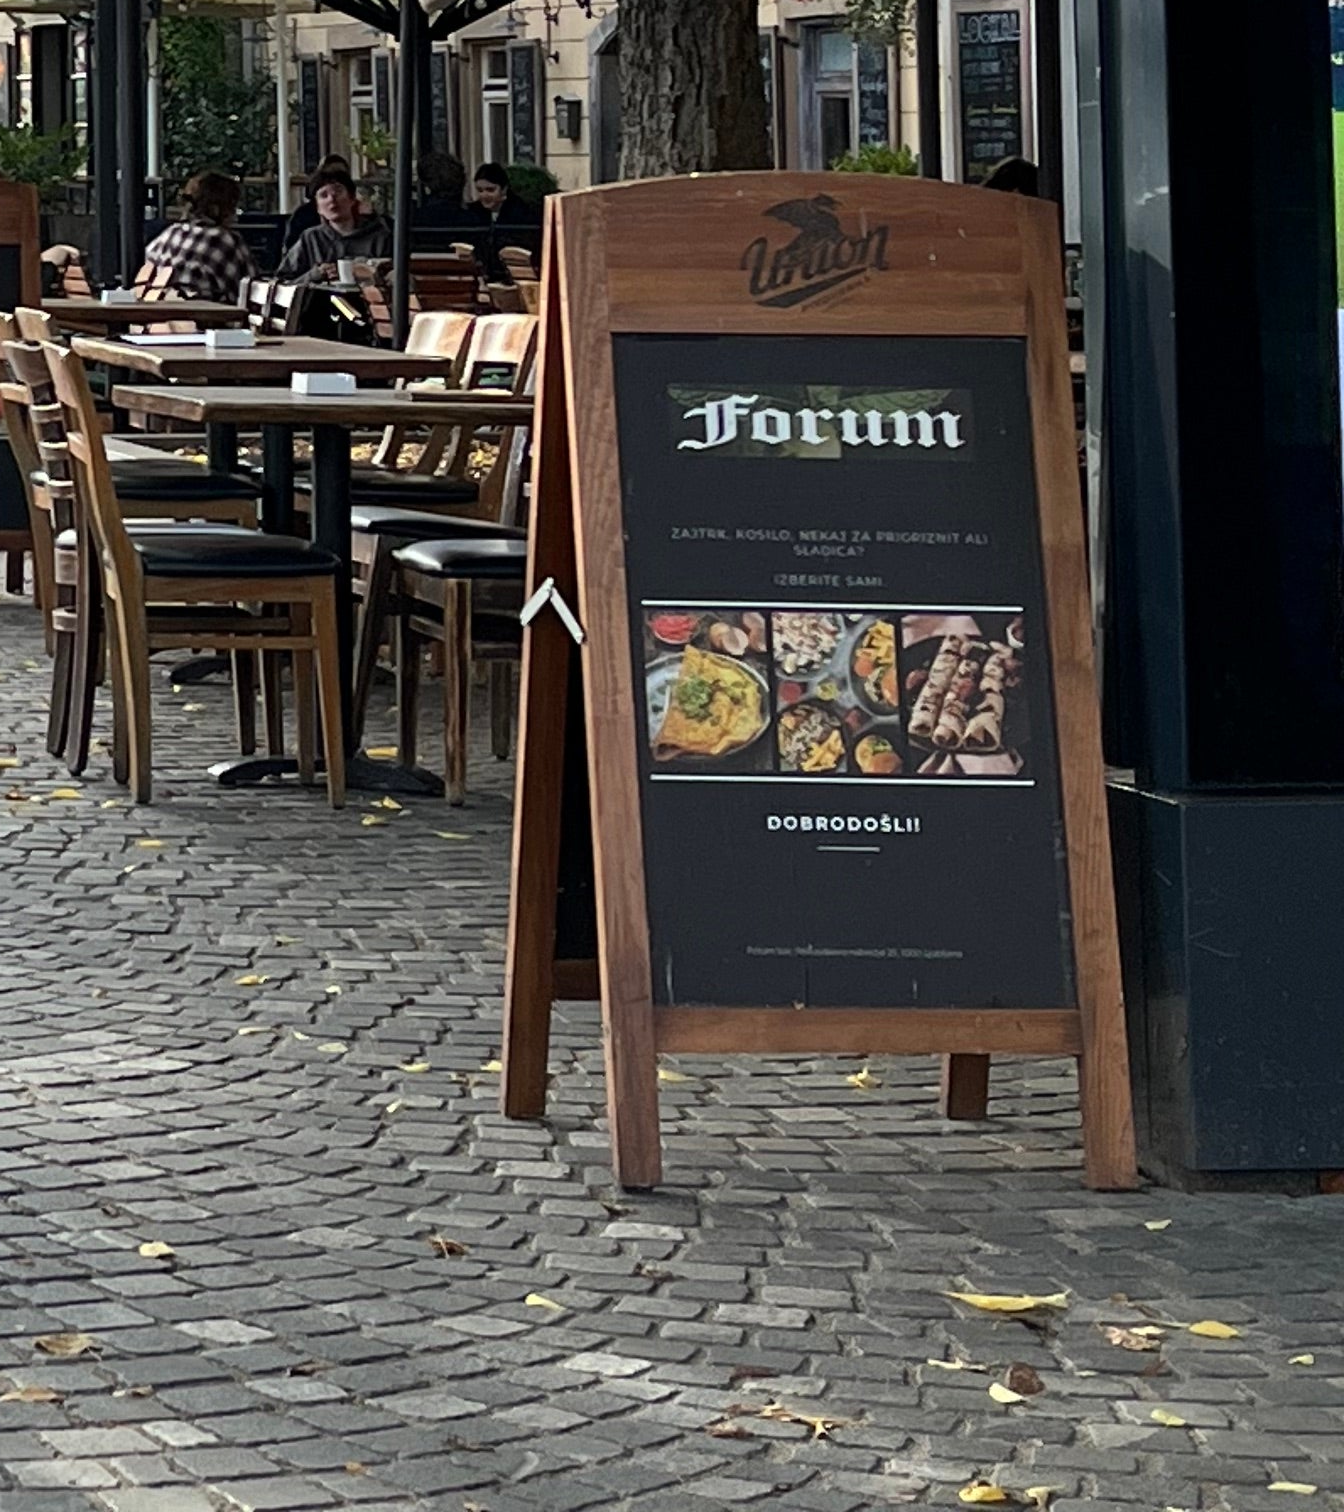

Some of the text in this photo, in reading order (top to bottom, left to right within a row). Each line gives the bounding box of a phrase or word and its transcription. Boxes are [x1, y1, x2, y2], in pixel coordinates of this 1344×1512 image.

[740, 224, 890, 295] Union
[676, 393, 966, 452] Forum
[851, 530, 872, 543] ZA
[775, 573, 841, 587] IZBERITE
[767, 813, 920, 834] DOBRODOŠLI!
